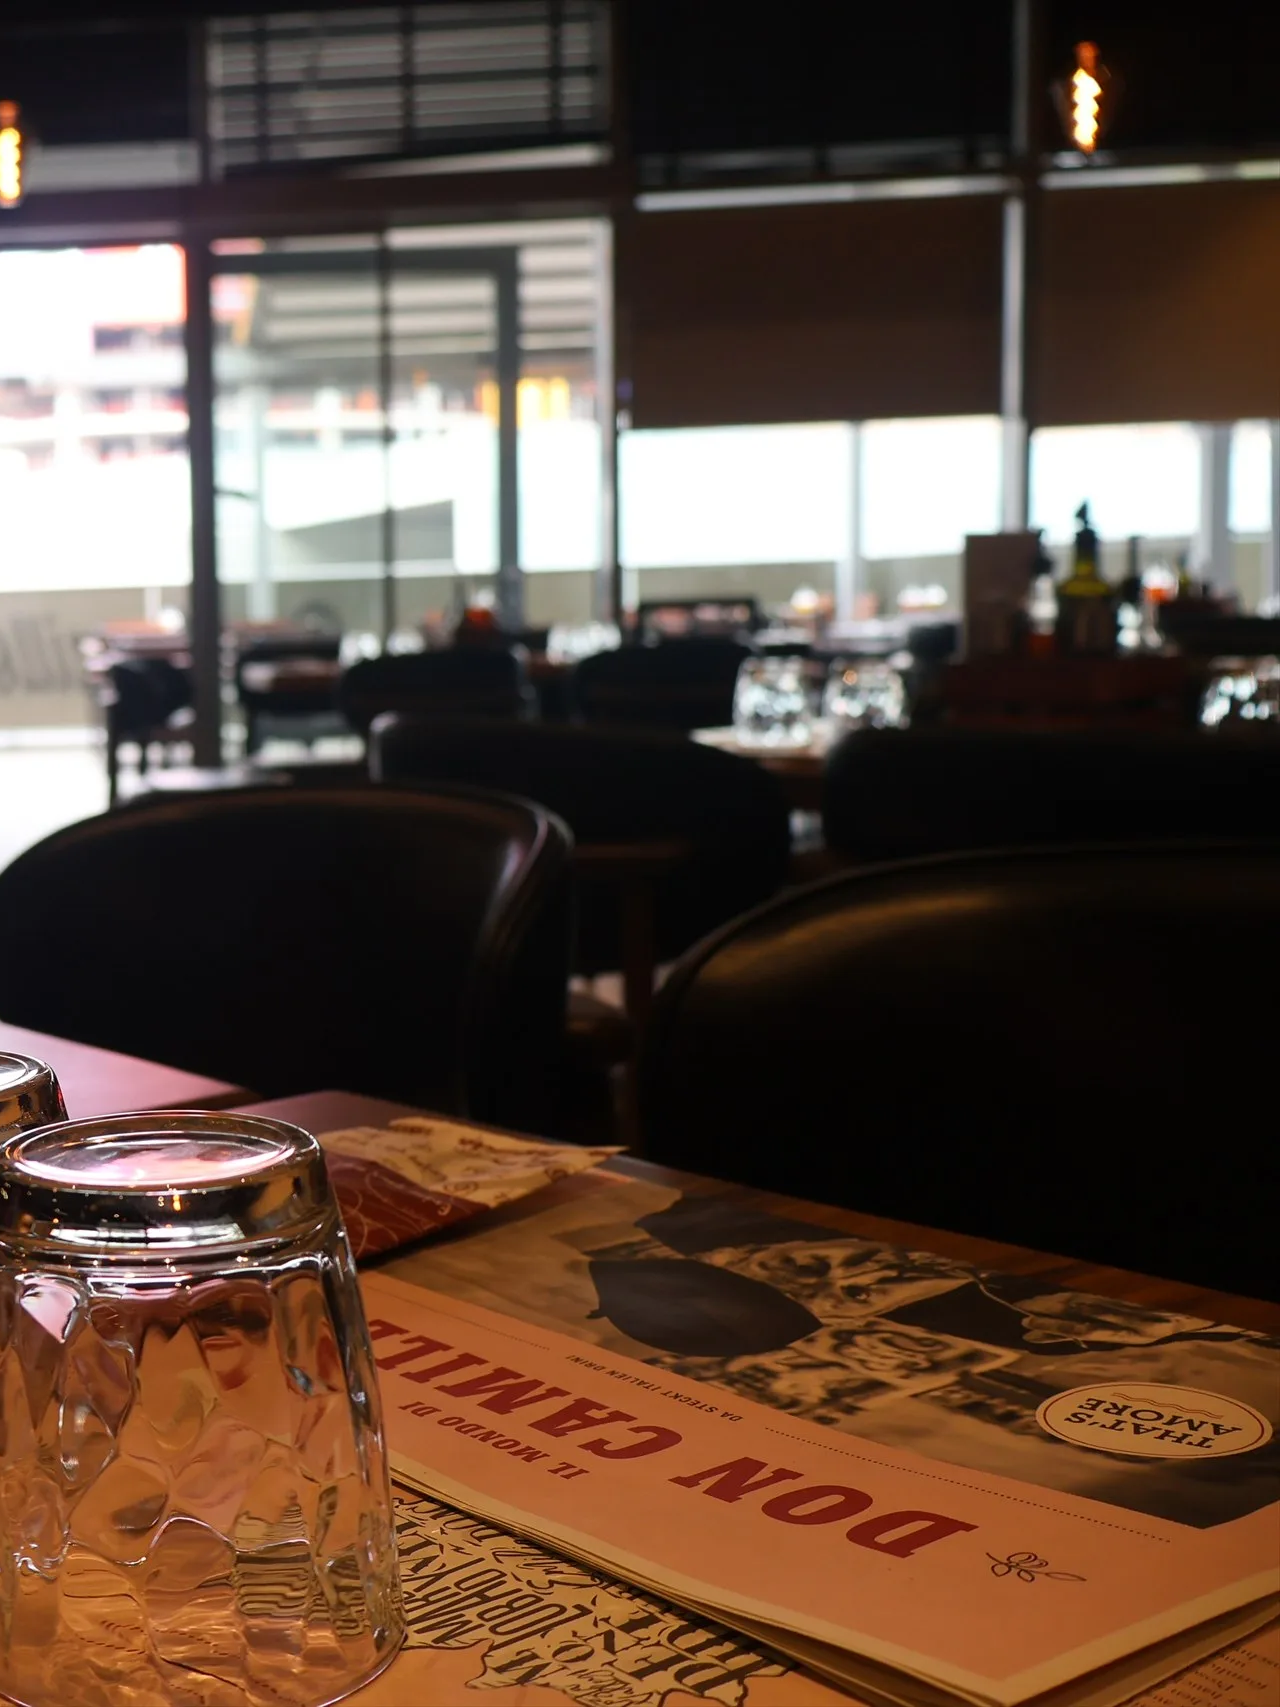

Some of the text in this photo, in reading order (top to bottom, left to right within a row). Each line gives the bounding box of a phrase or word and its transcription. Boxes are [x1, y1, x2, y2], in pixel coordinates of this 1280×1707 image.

[605, 1369, 662, 1392] ITALIEN
[660, 1389, 719, 1414] STECKT
[719, 1410, 744, 1423] DA
[1077, 1397, 1243, 1437] AMORE
[367, 1318, 980, 1559] DON CAMILL
[397, 1400, 591, 1481] IL MONDO DI
[1063, 1411, 1216, 1449] THAT'S
